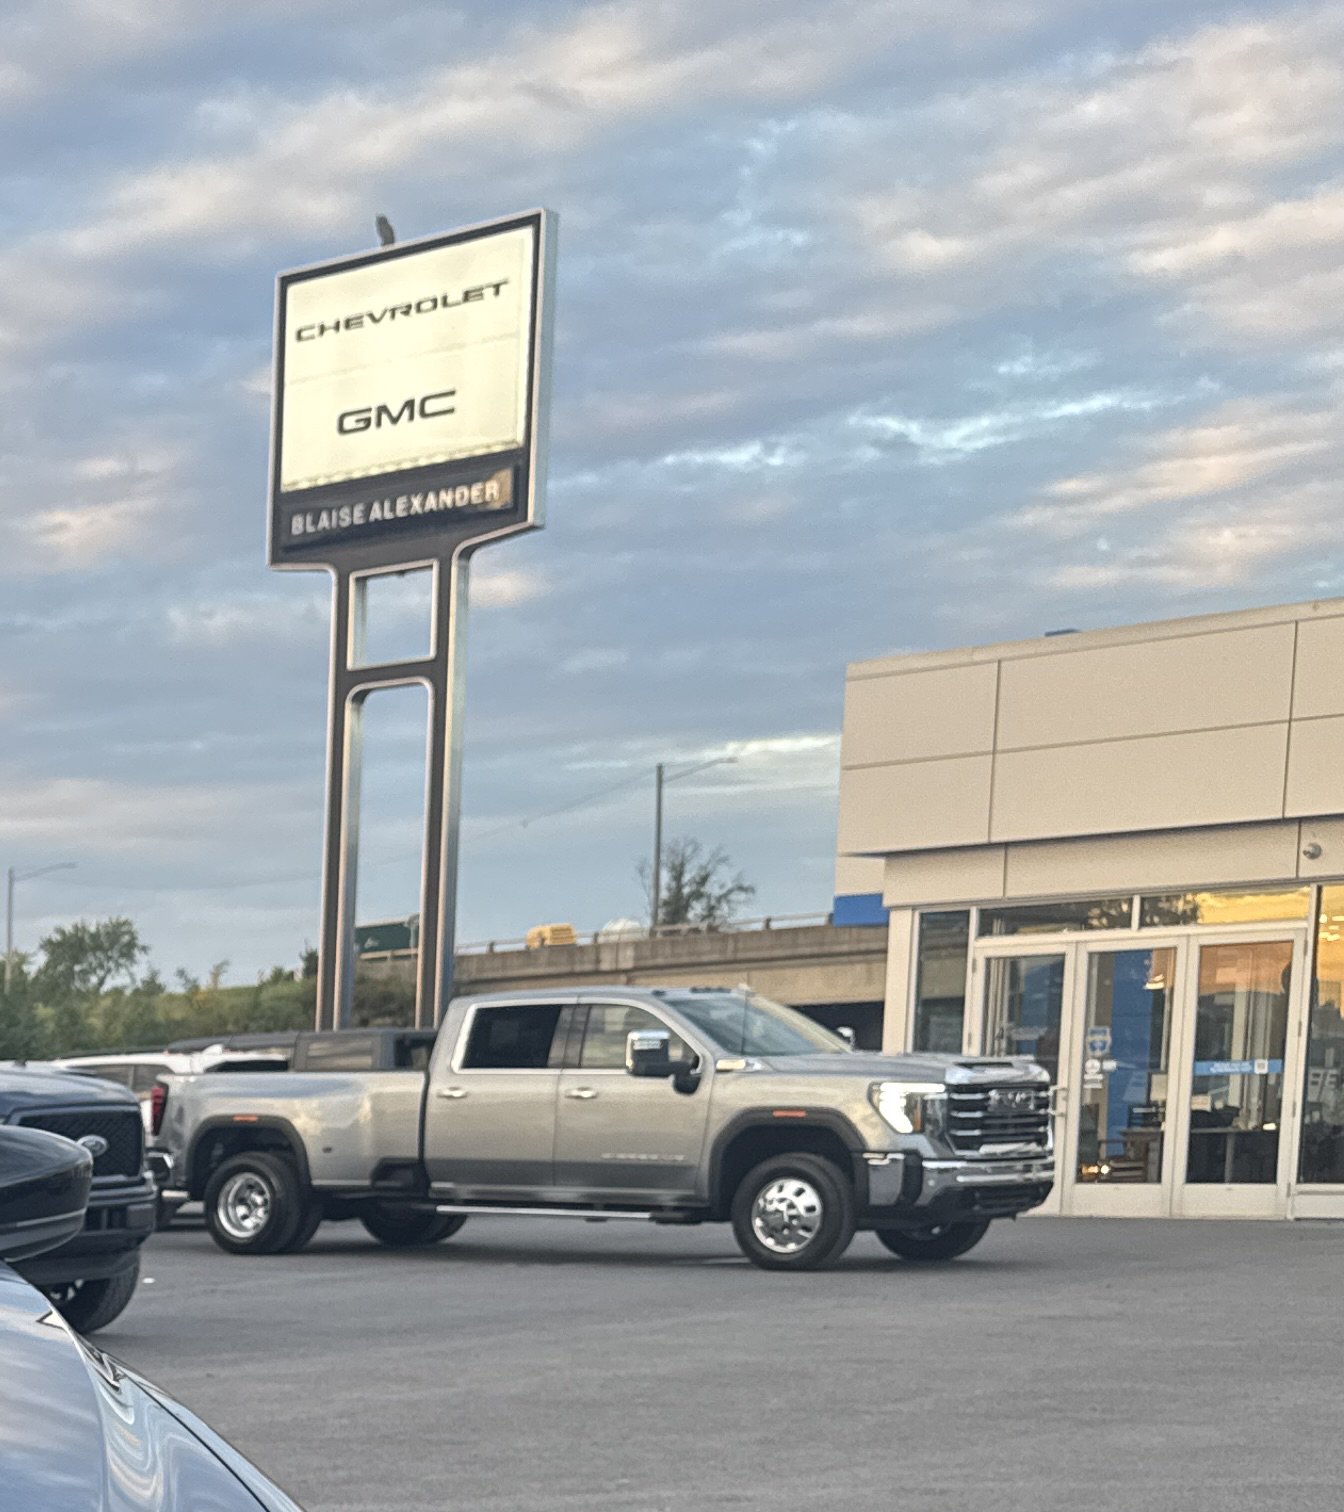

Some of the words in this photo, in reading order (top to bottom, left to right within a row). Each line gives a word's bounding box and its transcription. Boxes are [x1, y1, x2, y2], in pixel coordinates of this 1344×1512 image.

[295, 279, 509, 342] CHEVROLET
[337, 389, 456, 435] GMC
[291, 503, 370, 535] BLAISE
[368, 481, 499, 521] ALEXANDER
